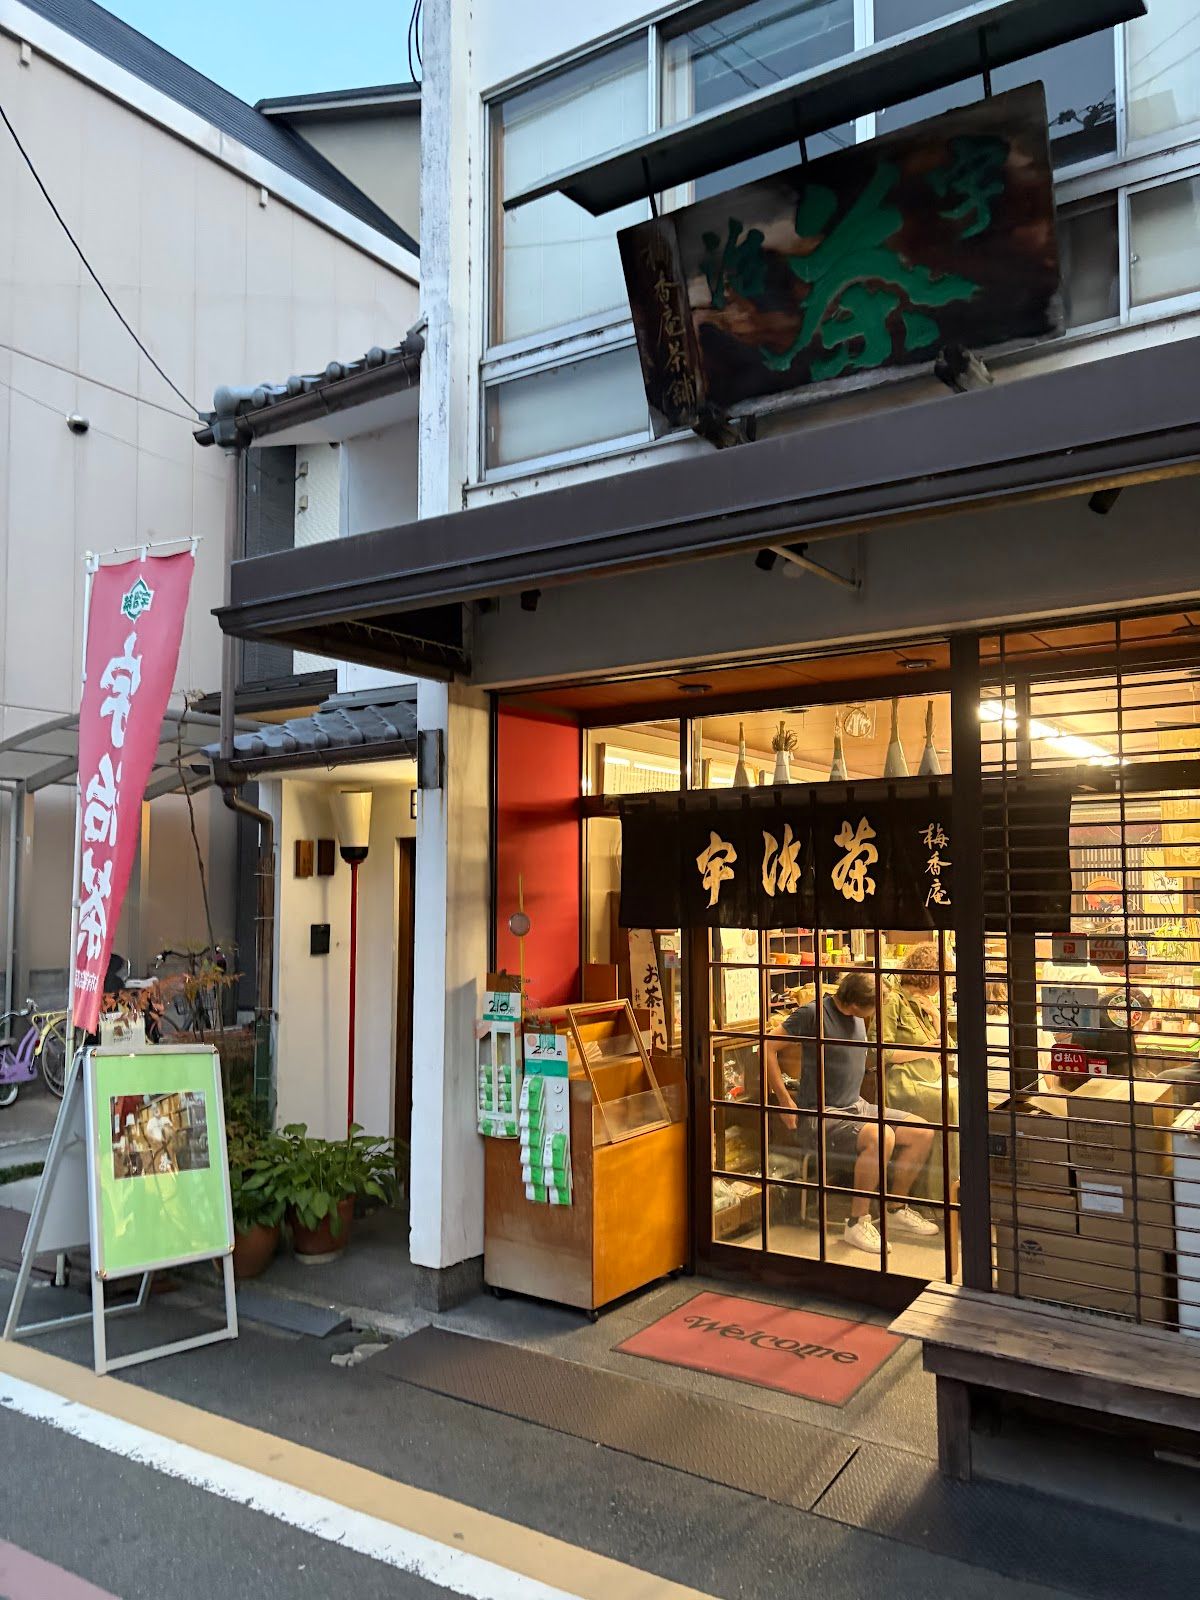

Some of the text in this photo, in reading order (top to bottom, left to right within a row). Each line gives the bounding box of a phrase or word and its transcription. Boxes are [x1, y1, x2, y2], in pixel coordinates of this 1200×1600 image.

[696, 815, 879, 909] 宇治茶
[918, 822, 953, 908] 梅香庵
[1054, 1053, 1083, 1063] d払い
[684, 1315, 859, 1364] Welcome
